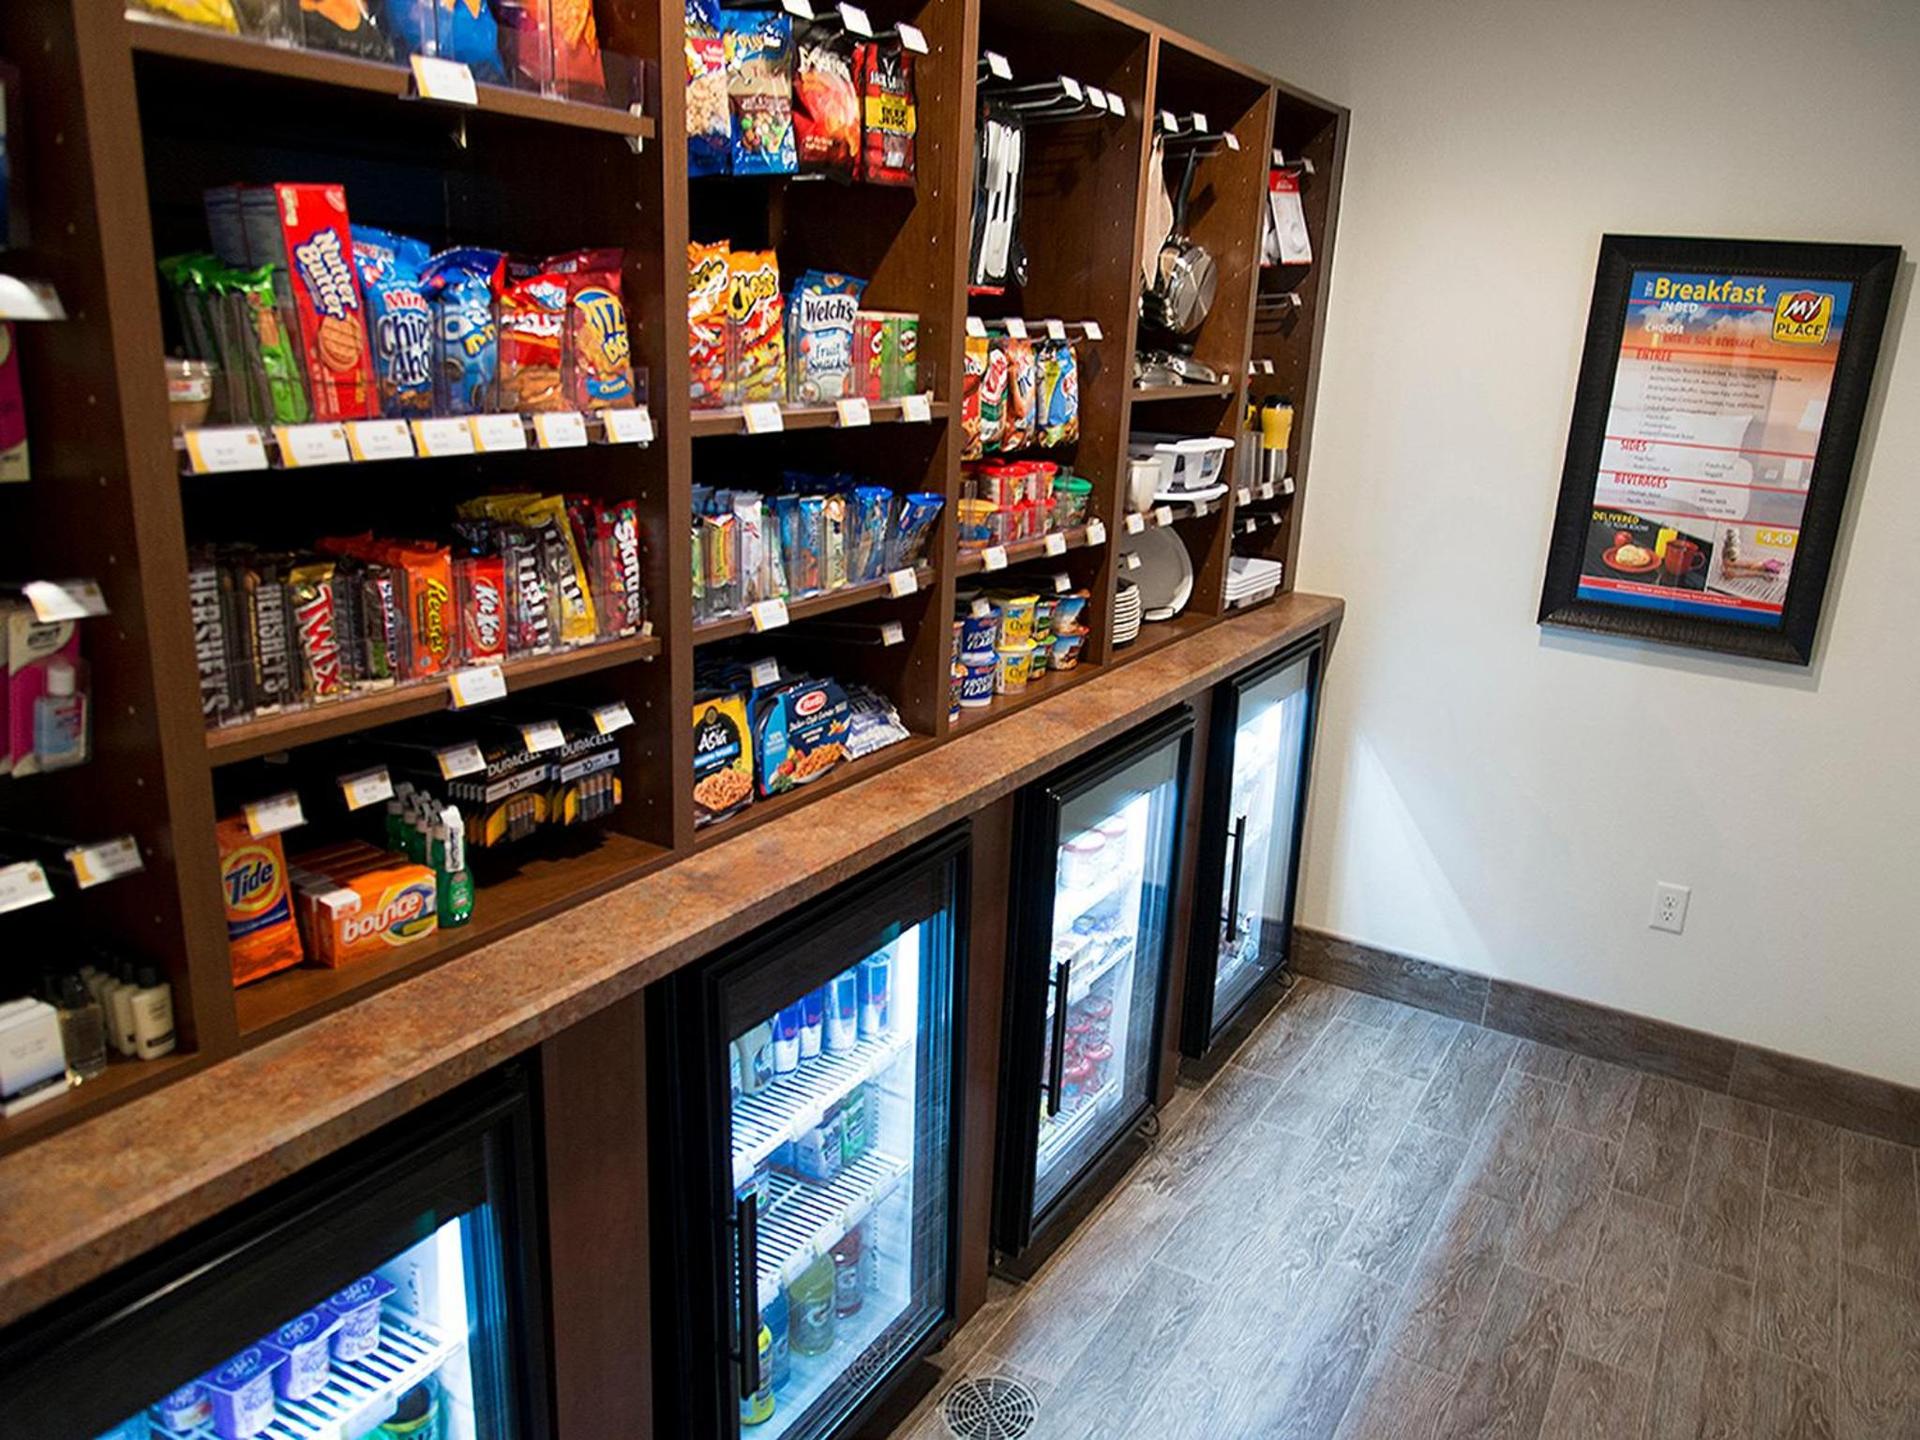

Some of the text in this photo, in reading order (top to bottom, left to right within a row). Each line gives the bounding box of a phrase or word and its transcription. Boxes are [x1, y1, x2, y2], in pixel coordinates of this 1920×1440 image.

[296, 244, 345, 319] Butter
[313, 229, 358, 311] Nutter
[1654, 277, 1767, 305] Breakfast
[804, 299, 854, 322] Welch's
[1783, 295, 1824, 322] MY
[1775, 320, 1825, 337] PLACE
[1635, 350, 1673, 363] ENTREE
[1619, 439, 1648, 453] SIDES
[1613, 473, 1669, 489] BEVERAGES
[1592, 511, 1640, 525] DELIVERED
[189, 567, 231, 715] HERSHEY'S
[296, 582, 342, 695] TWIX
[560, 734, 615, 758] DURACELL
[487, 750, 542, 777] DURACELL
[224, 860, 274, 905] Tide
[342, 890, 424, 948] bounce
